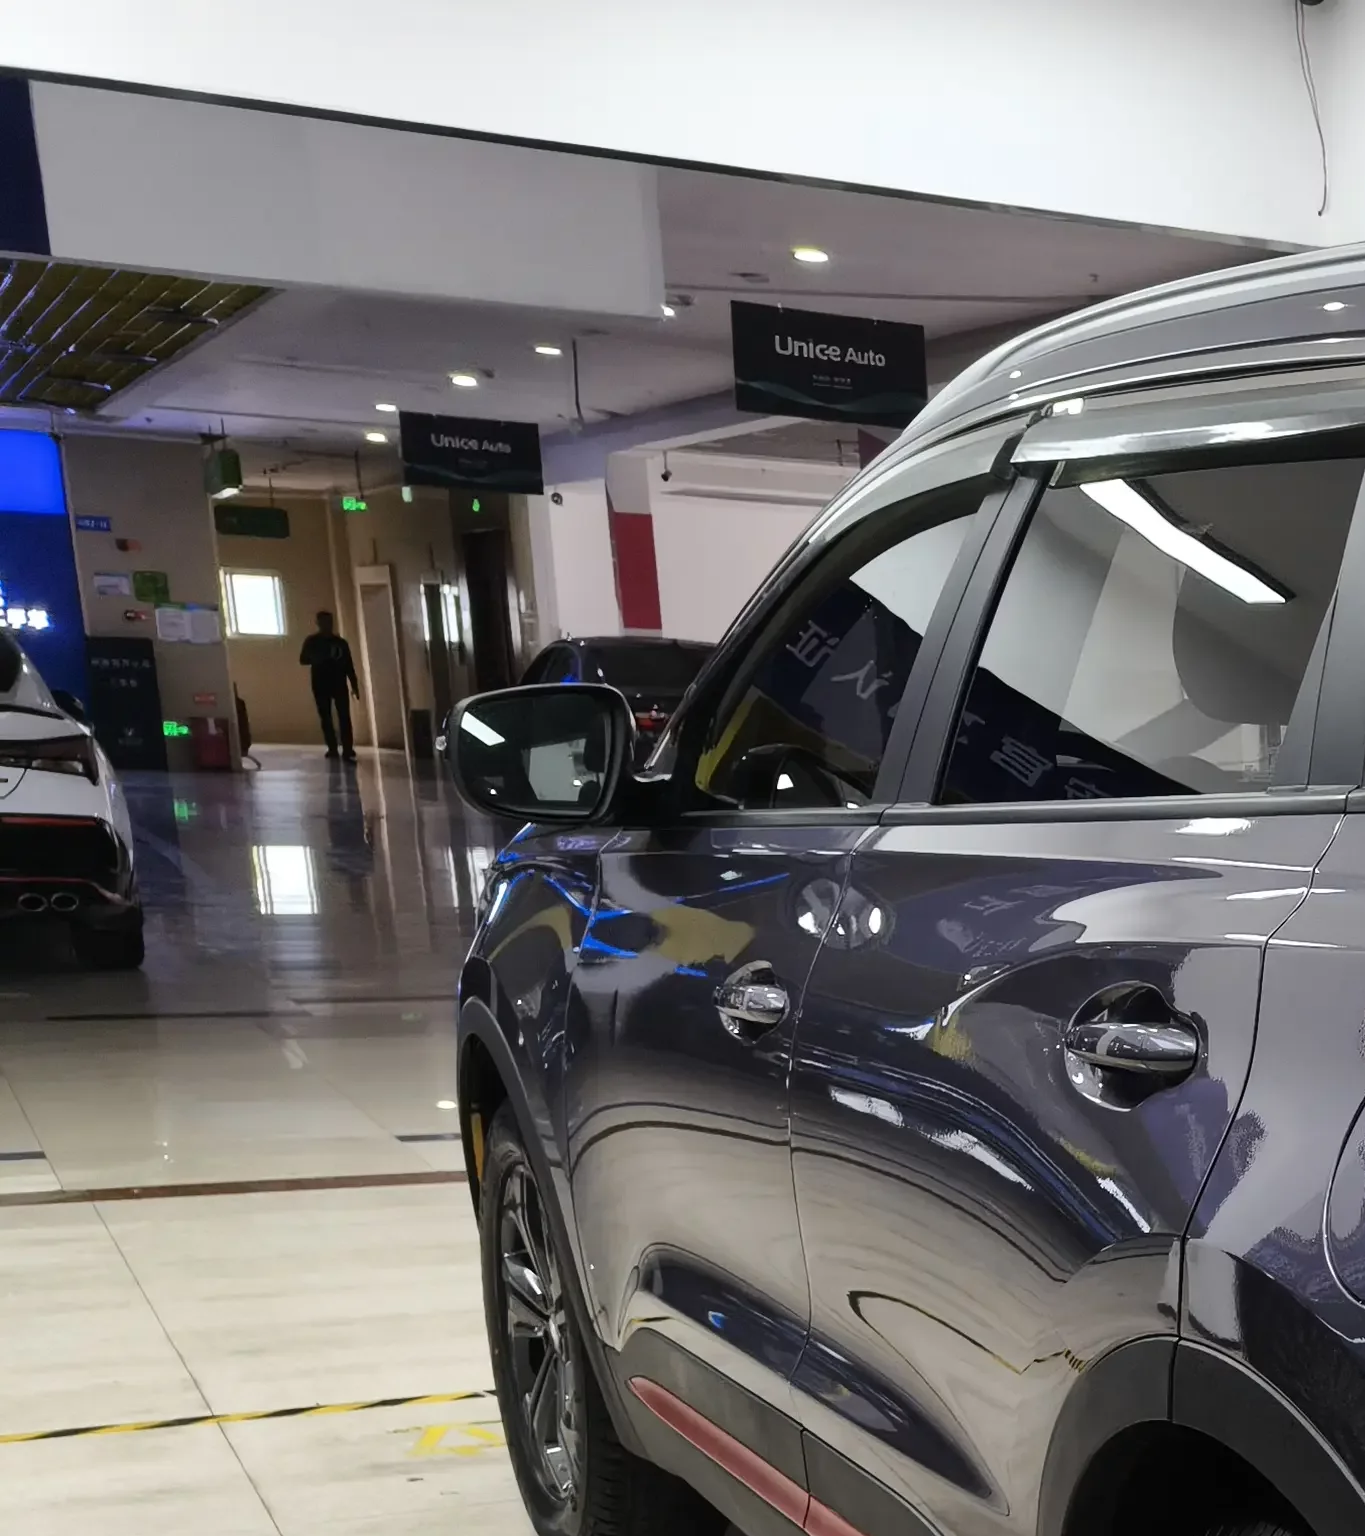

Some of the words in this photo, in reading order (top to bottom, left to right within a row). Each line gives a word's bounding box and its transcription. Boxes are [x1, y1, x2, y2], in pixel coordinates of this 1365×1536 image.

[775, 335, 840, 361] Unice
[845, 347, 885, 366] Auto
[431, 433, 478, 450] Unice
[482, 440, 511, 453] Auto
